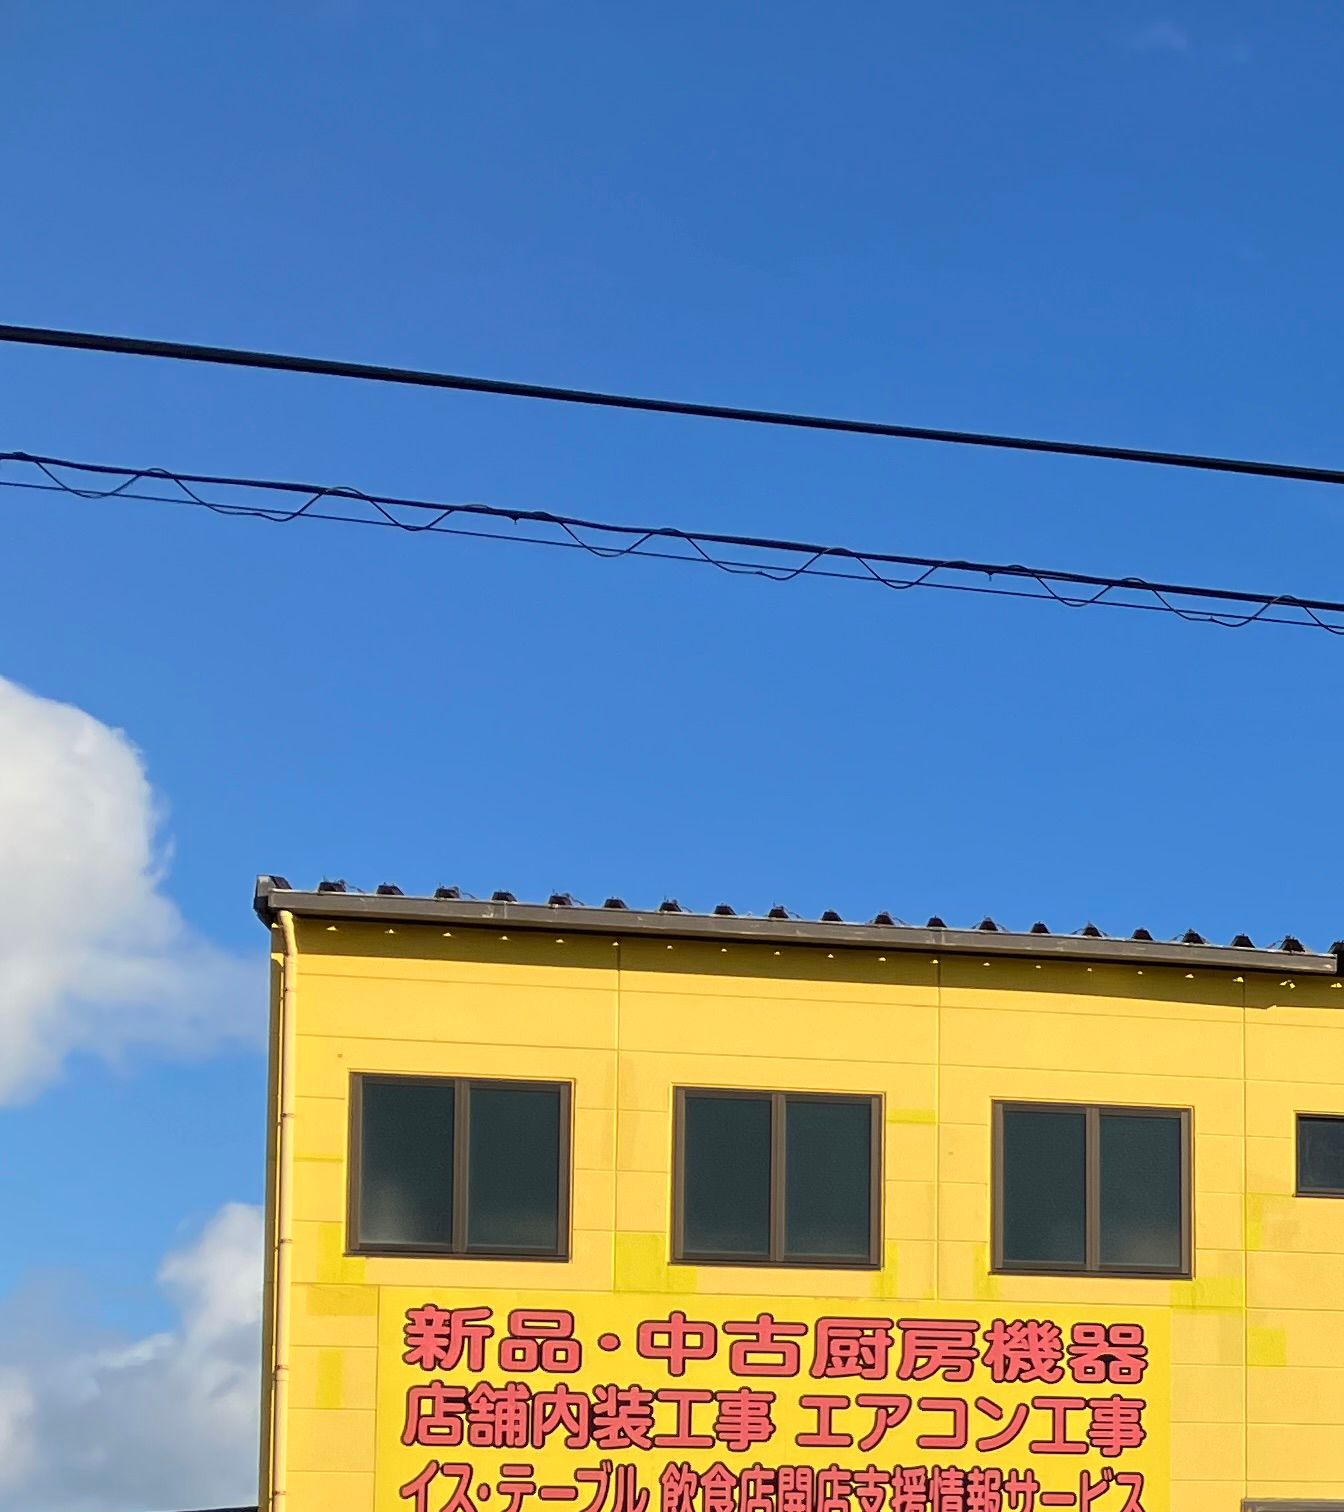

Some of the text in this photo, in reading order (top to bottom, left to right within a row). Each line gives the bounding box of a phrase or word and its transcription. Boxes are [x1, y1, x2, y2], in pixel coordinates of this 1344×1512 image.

[402, 1303, 1149, 1386] 新品・中古厨房機器
[401, 1378, 1148, 1459] 店舗内装工事 エアコン工事
